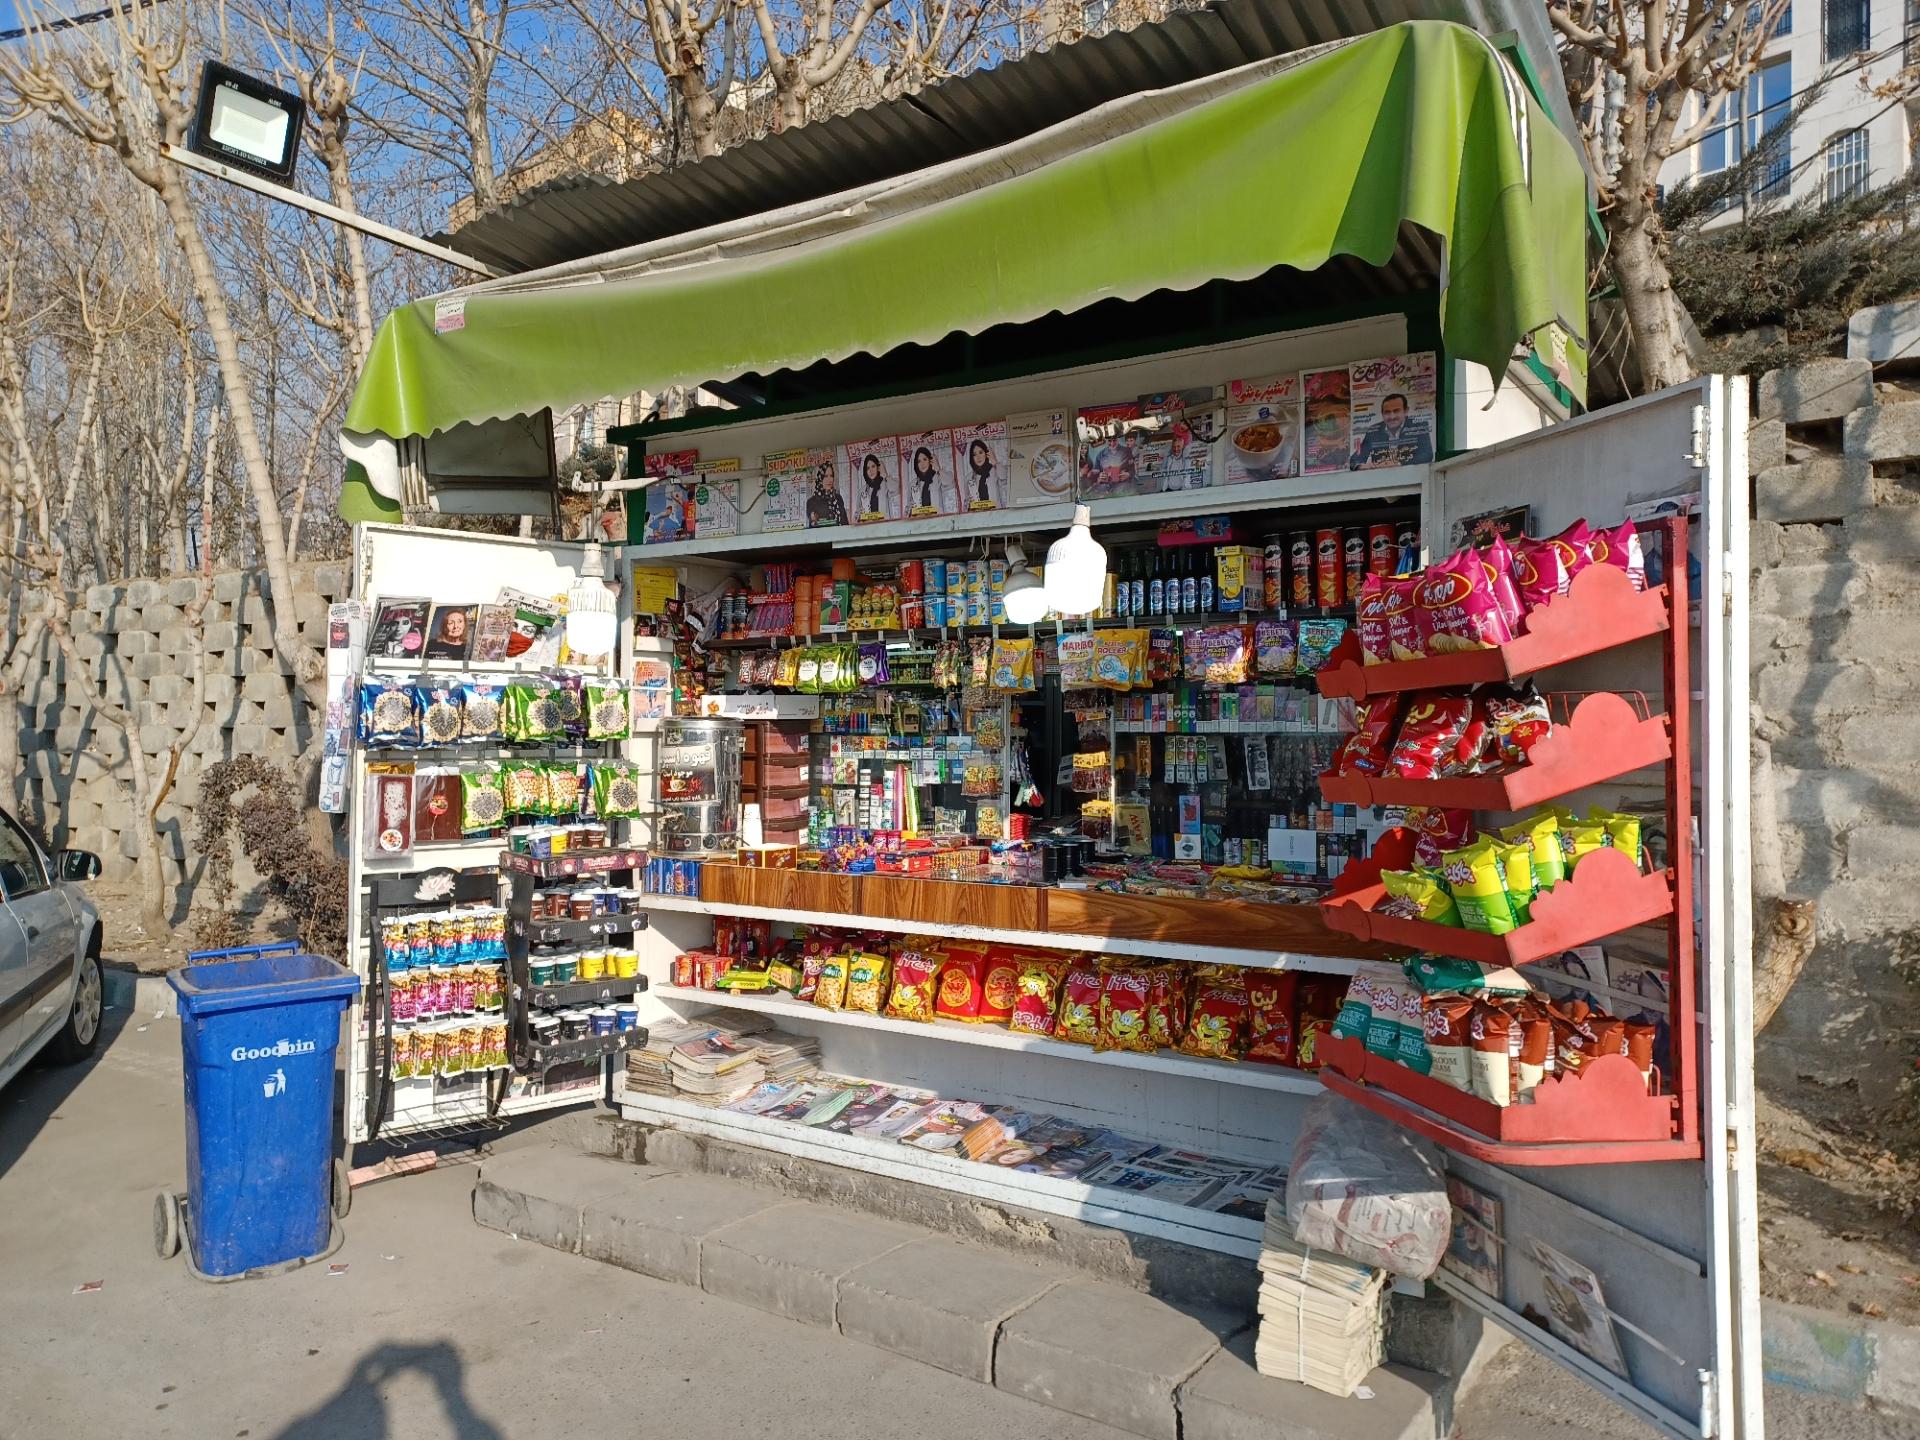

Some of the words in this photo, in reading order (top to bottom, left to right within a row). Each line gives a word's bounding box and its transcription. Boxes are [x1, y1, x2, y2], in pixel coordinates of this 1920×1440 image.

[927, 432, 950, 444] دنیای
[955, 429, 979, 440] جدول
[982, 426, 1005, 438] دنیای
[876, 440, 895, 453] دنیای
[902, 437, 925, 447] جدول
[850, 444, 872, 455] جدول
[1062, 639, 1094, 651] HARIBO
[1207, 638, 1236, 647] BEBETO
[683, 745, 711, 767] قهوه
[231, 1040, 316, 1062] Goodbin
